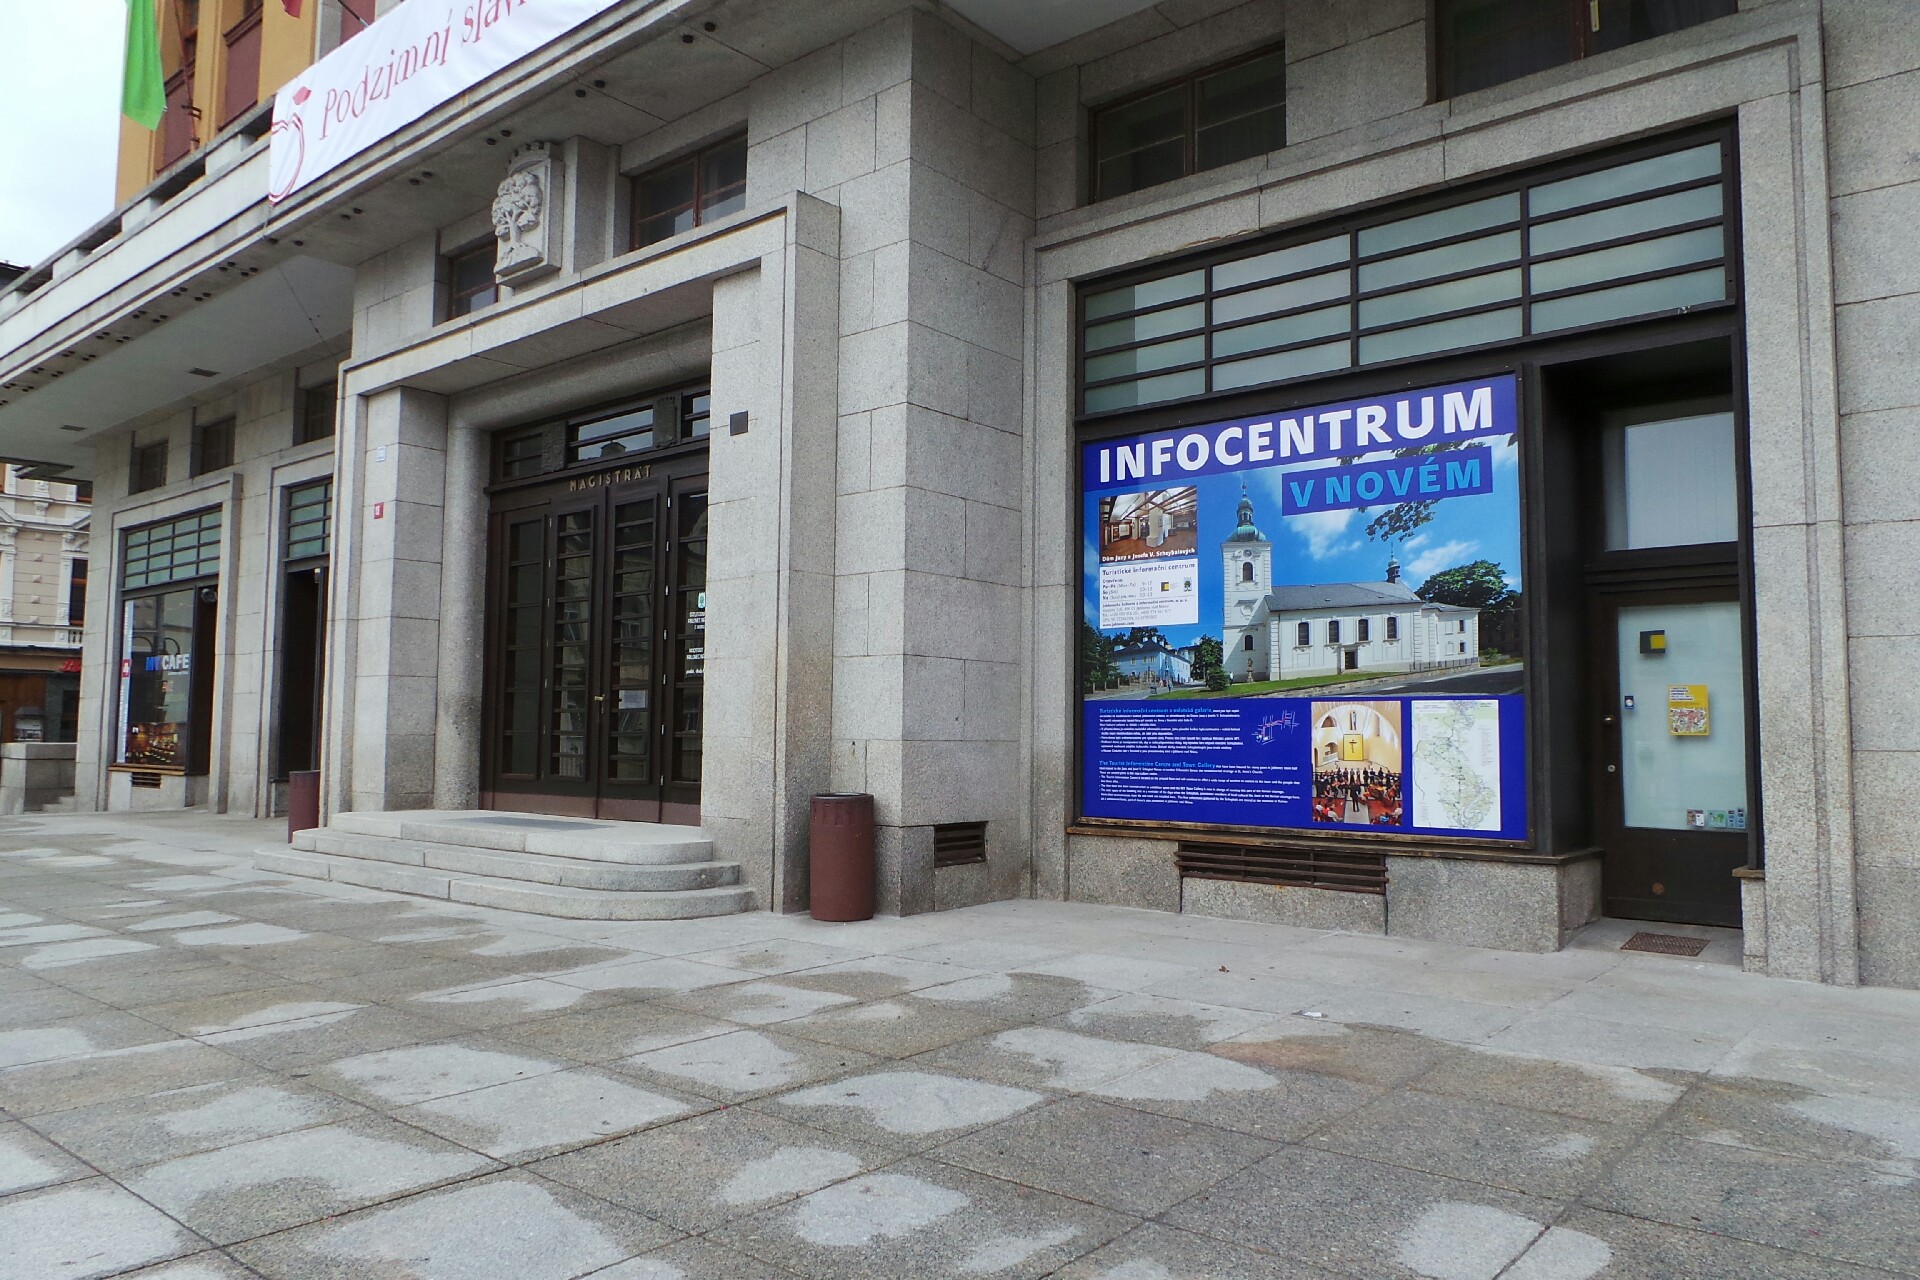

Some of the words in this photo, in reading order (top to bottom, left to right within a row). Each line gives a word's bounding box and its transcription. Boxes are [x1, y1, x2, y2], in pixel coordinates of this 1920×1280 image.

[319, 8, 453, 140] Podzimní
[461, 0, 527, 47] slav
[1100, 386, 1493, 483] INFOCENTRUM
[1289, 481, 1315, 509] V
[1325, 457, 1481, 504] NOVÉM
[1102, 567, 1132, 576] Turistické
[1132, 564, 1167, 573] informační
[1168, 562, 1196, 571] centrum
[162, 653, 190, 670] CAFE
